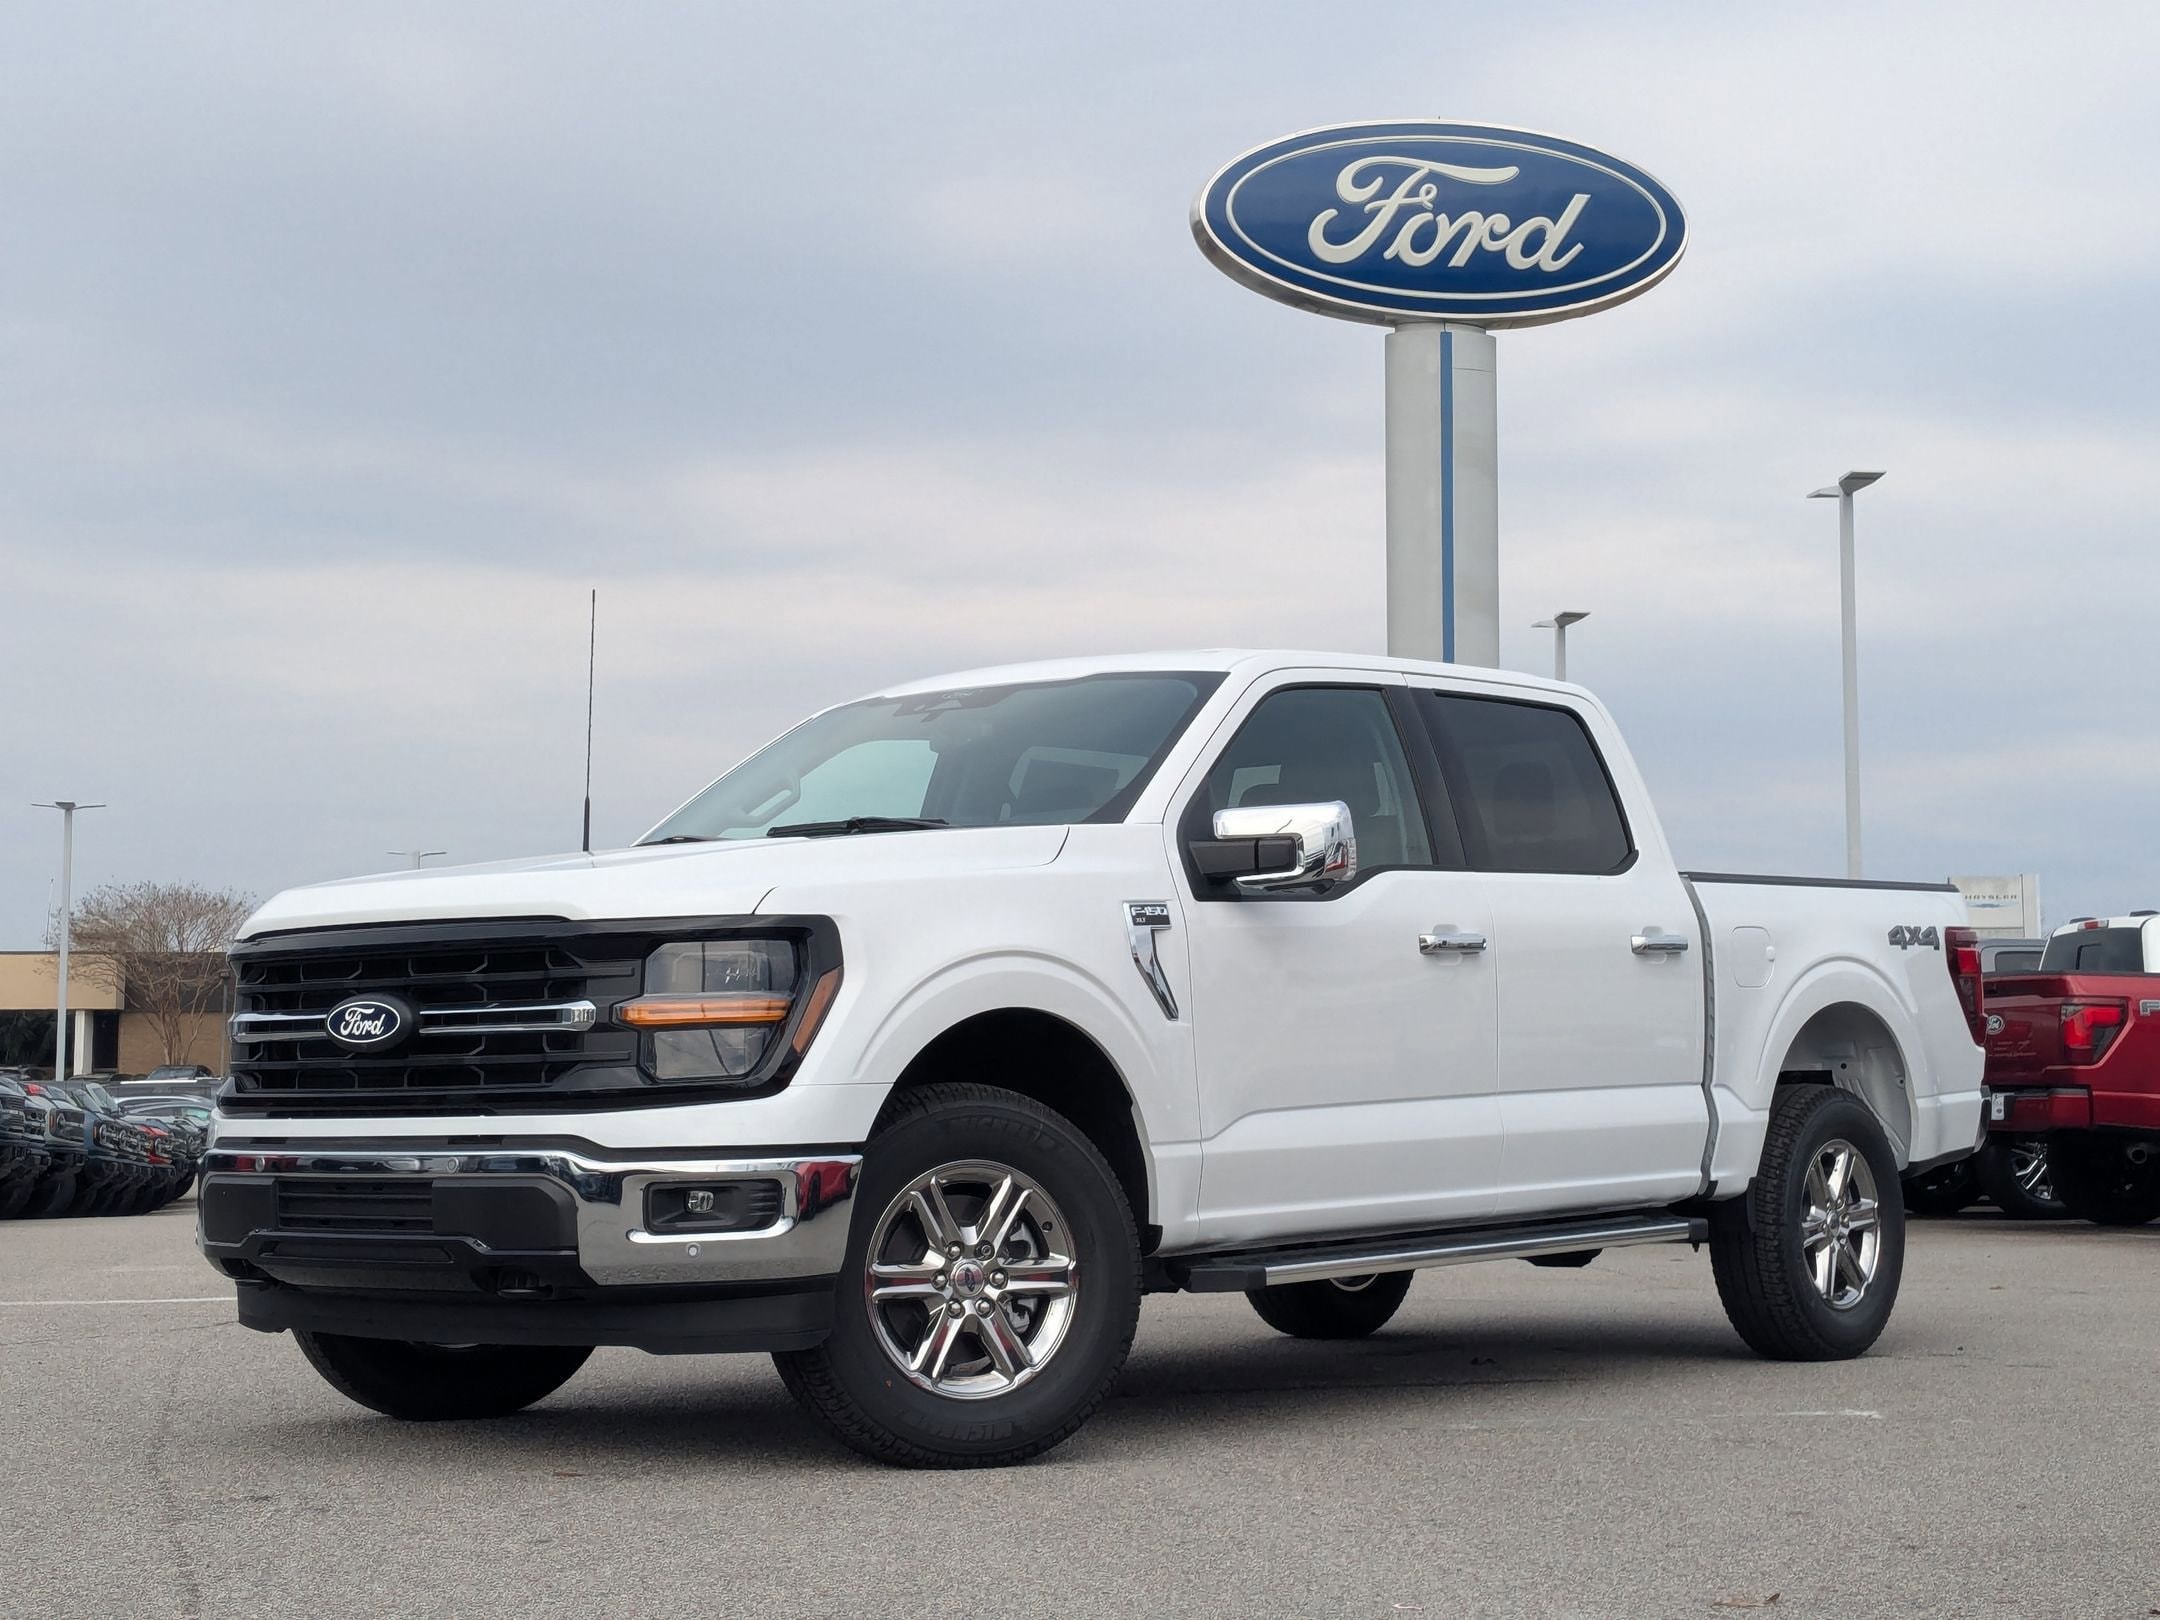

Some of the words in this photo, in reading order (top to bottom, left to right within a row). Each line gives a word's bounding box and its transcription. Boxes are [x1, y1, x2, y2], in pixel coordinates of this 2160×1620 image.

[1307, 155, 1592, 272] Ford
[1130, 906, 1169, 916] F-150
[340, 1007, 386, 1035] Ford
